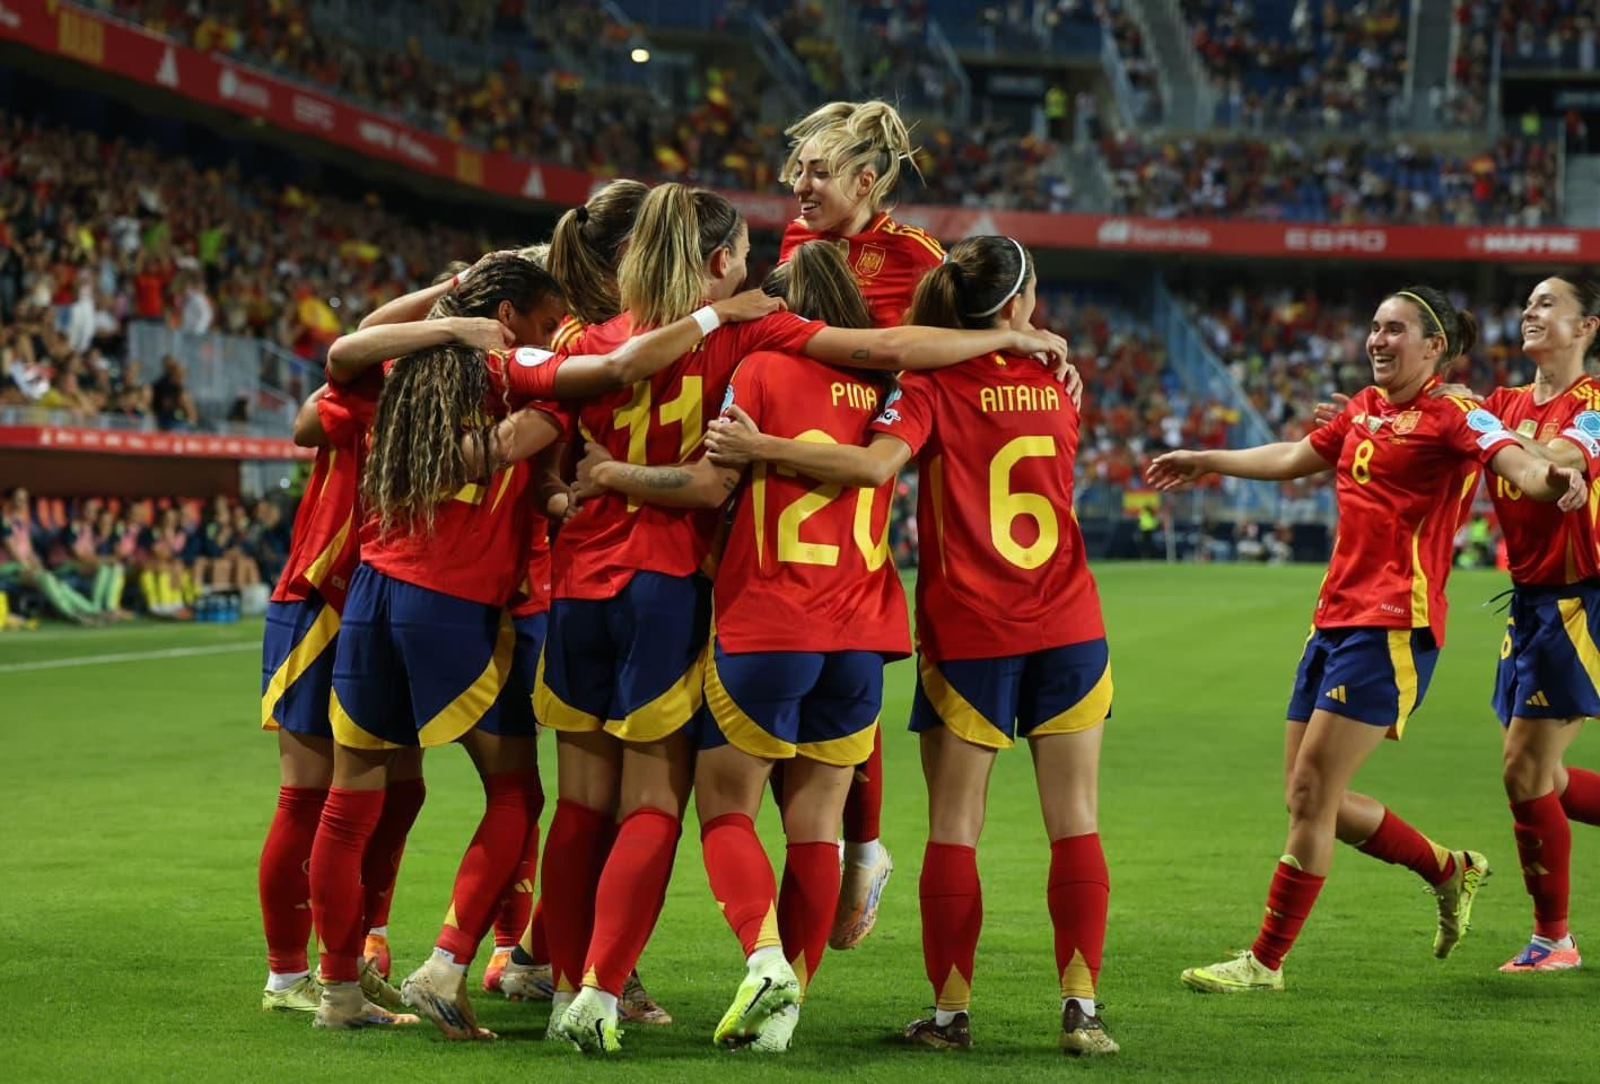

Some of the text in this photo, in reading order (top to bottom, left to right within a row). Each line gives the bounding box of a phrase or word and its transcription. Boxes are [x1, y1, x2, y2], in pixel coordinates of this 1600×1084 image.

[1284, 228, 1387, 253] EBRO
[830, 382, 877, 411] PINA
[980, 385, 1060, 412] AITANA
[613, 375, 703, 513] 11
[1351, 438, 1375, 485] 8
[989, 435, 1059, 570] 6
